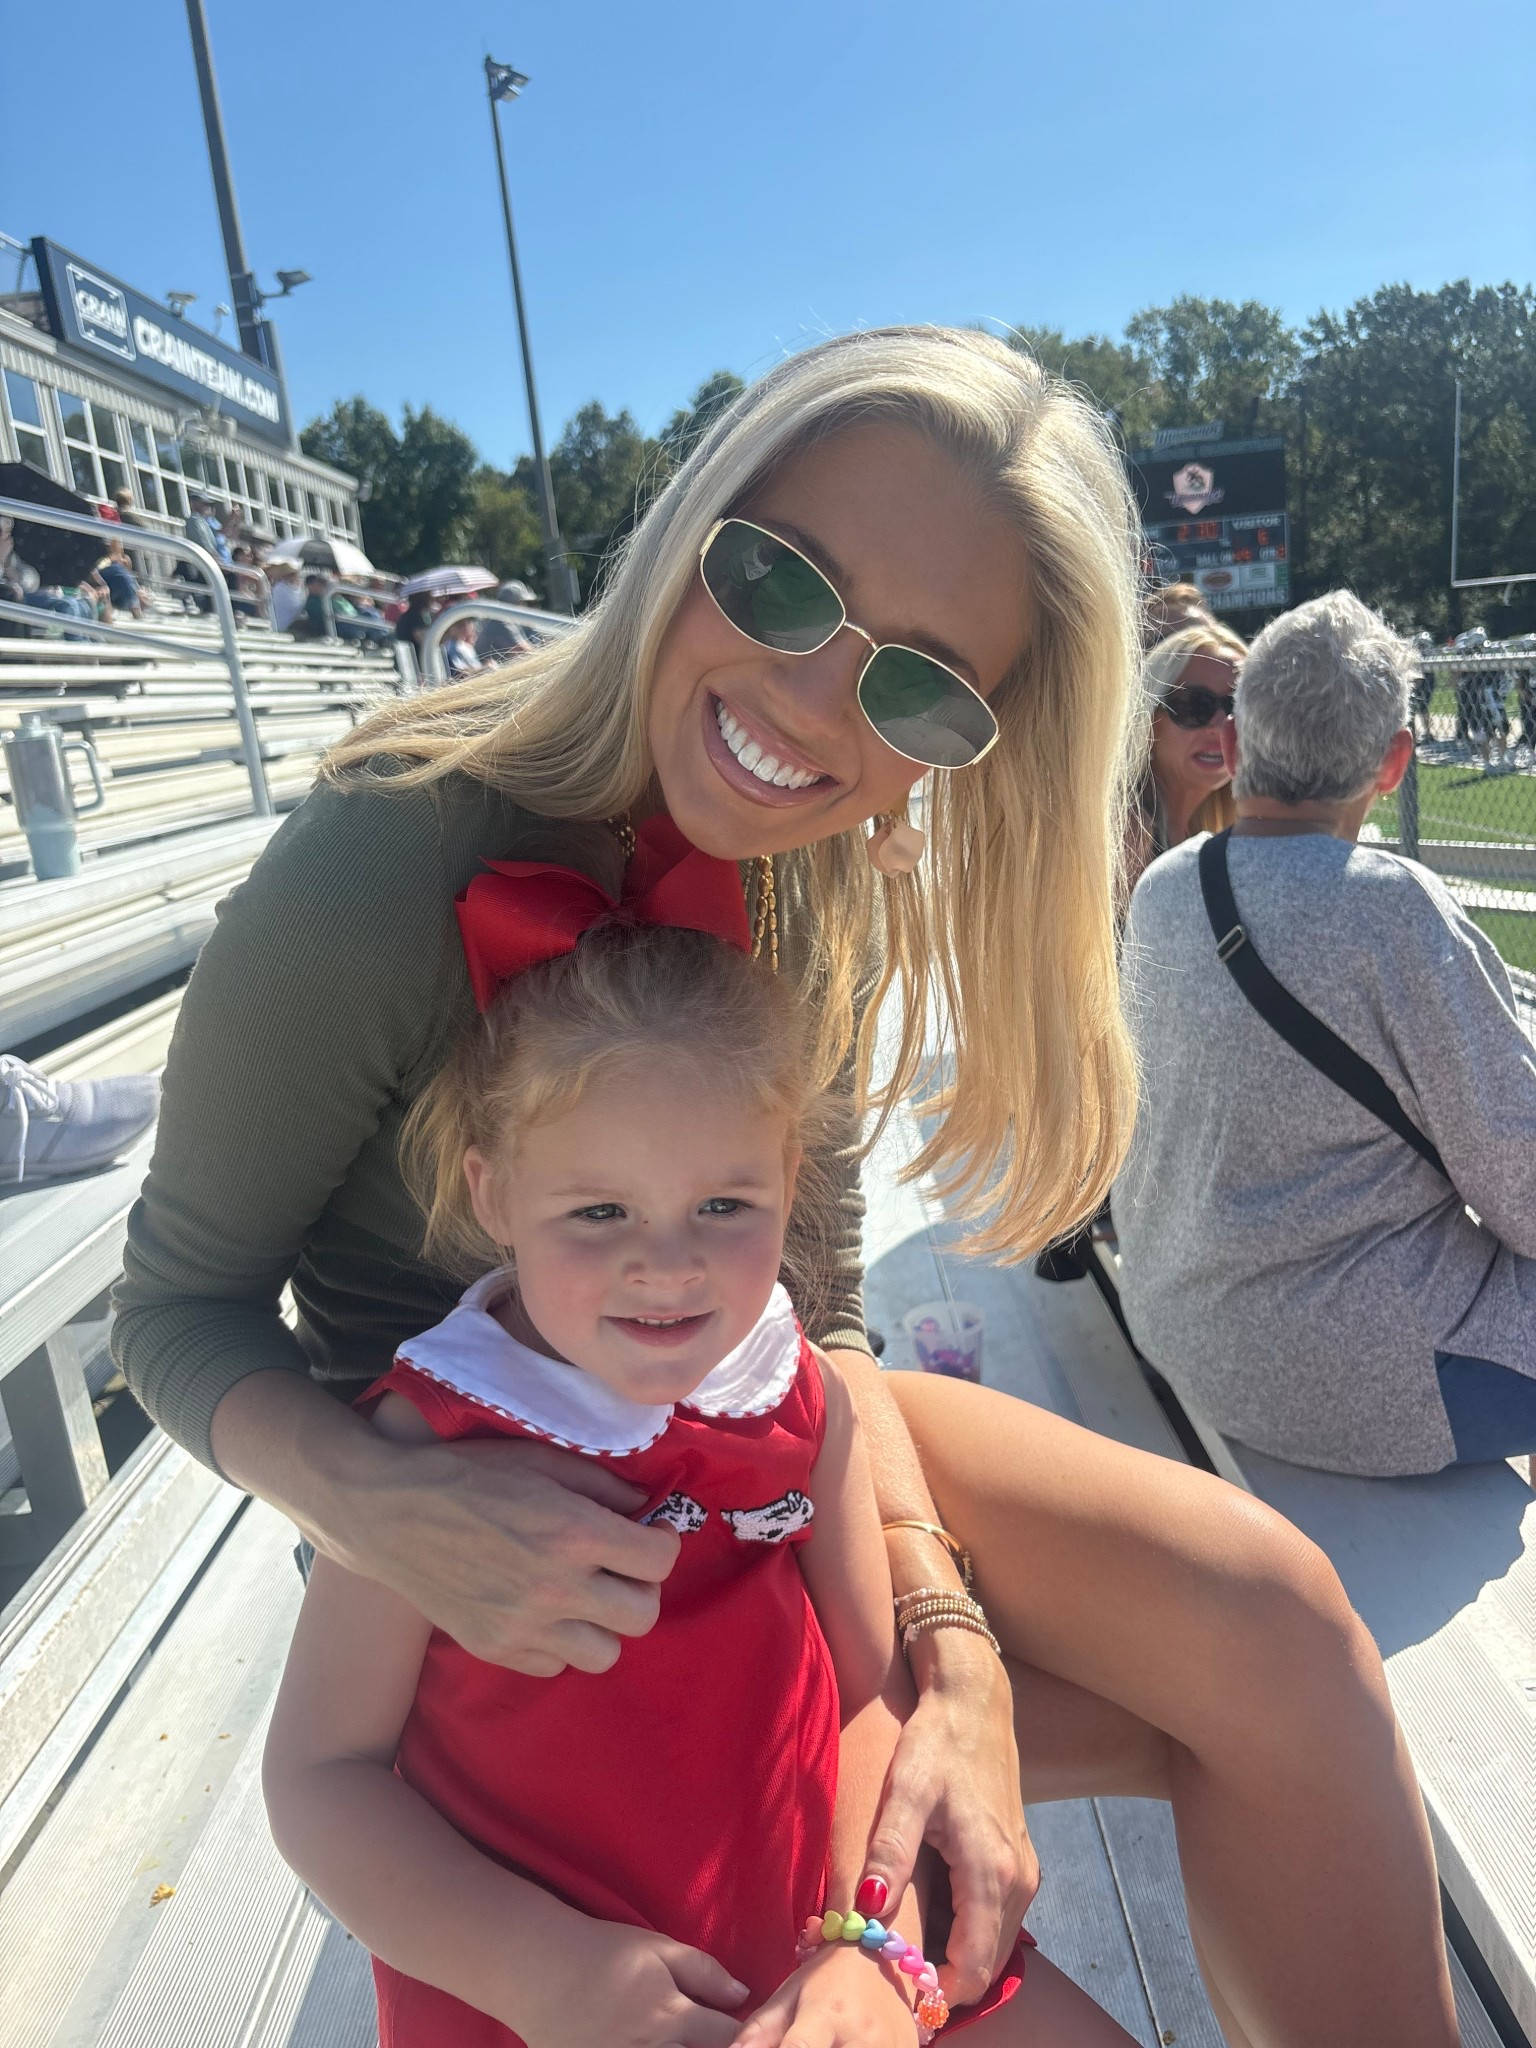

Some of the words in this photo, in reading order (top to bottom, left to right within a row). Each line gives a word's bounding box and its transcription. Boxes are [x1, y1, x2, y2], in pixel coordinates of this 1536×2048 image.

[77, 290, 127, 336] CRAIN
[133, 315, 280, 424] CRAINTEAM.COM
[1231, 515, 1279, 530] VISITOR
